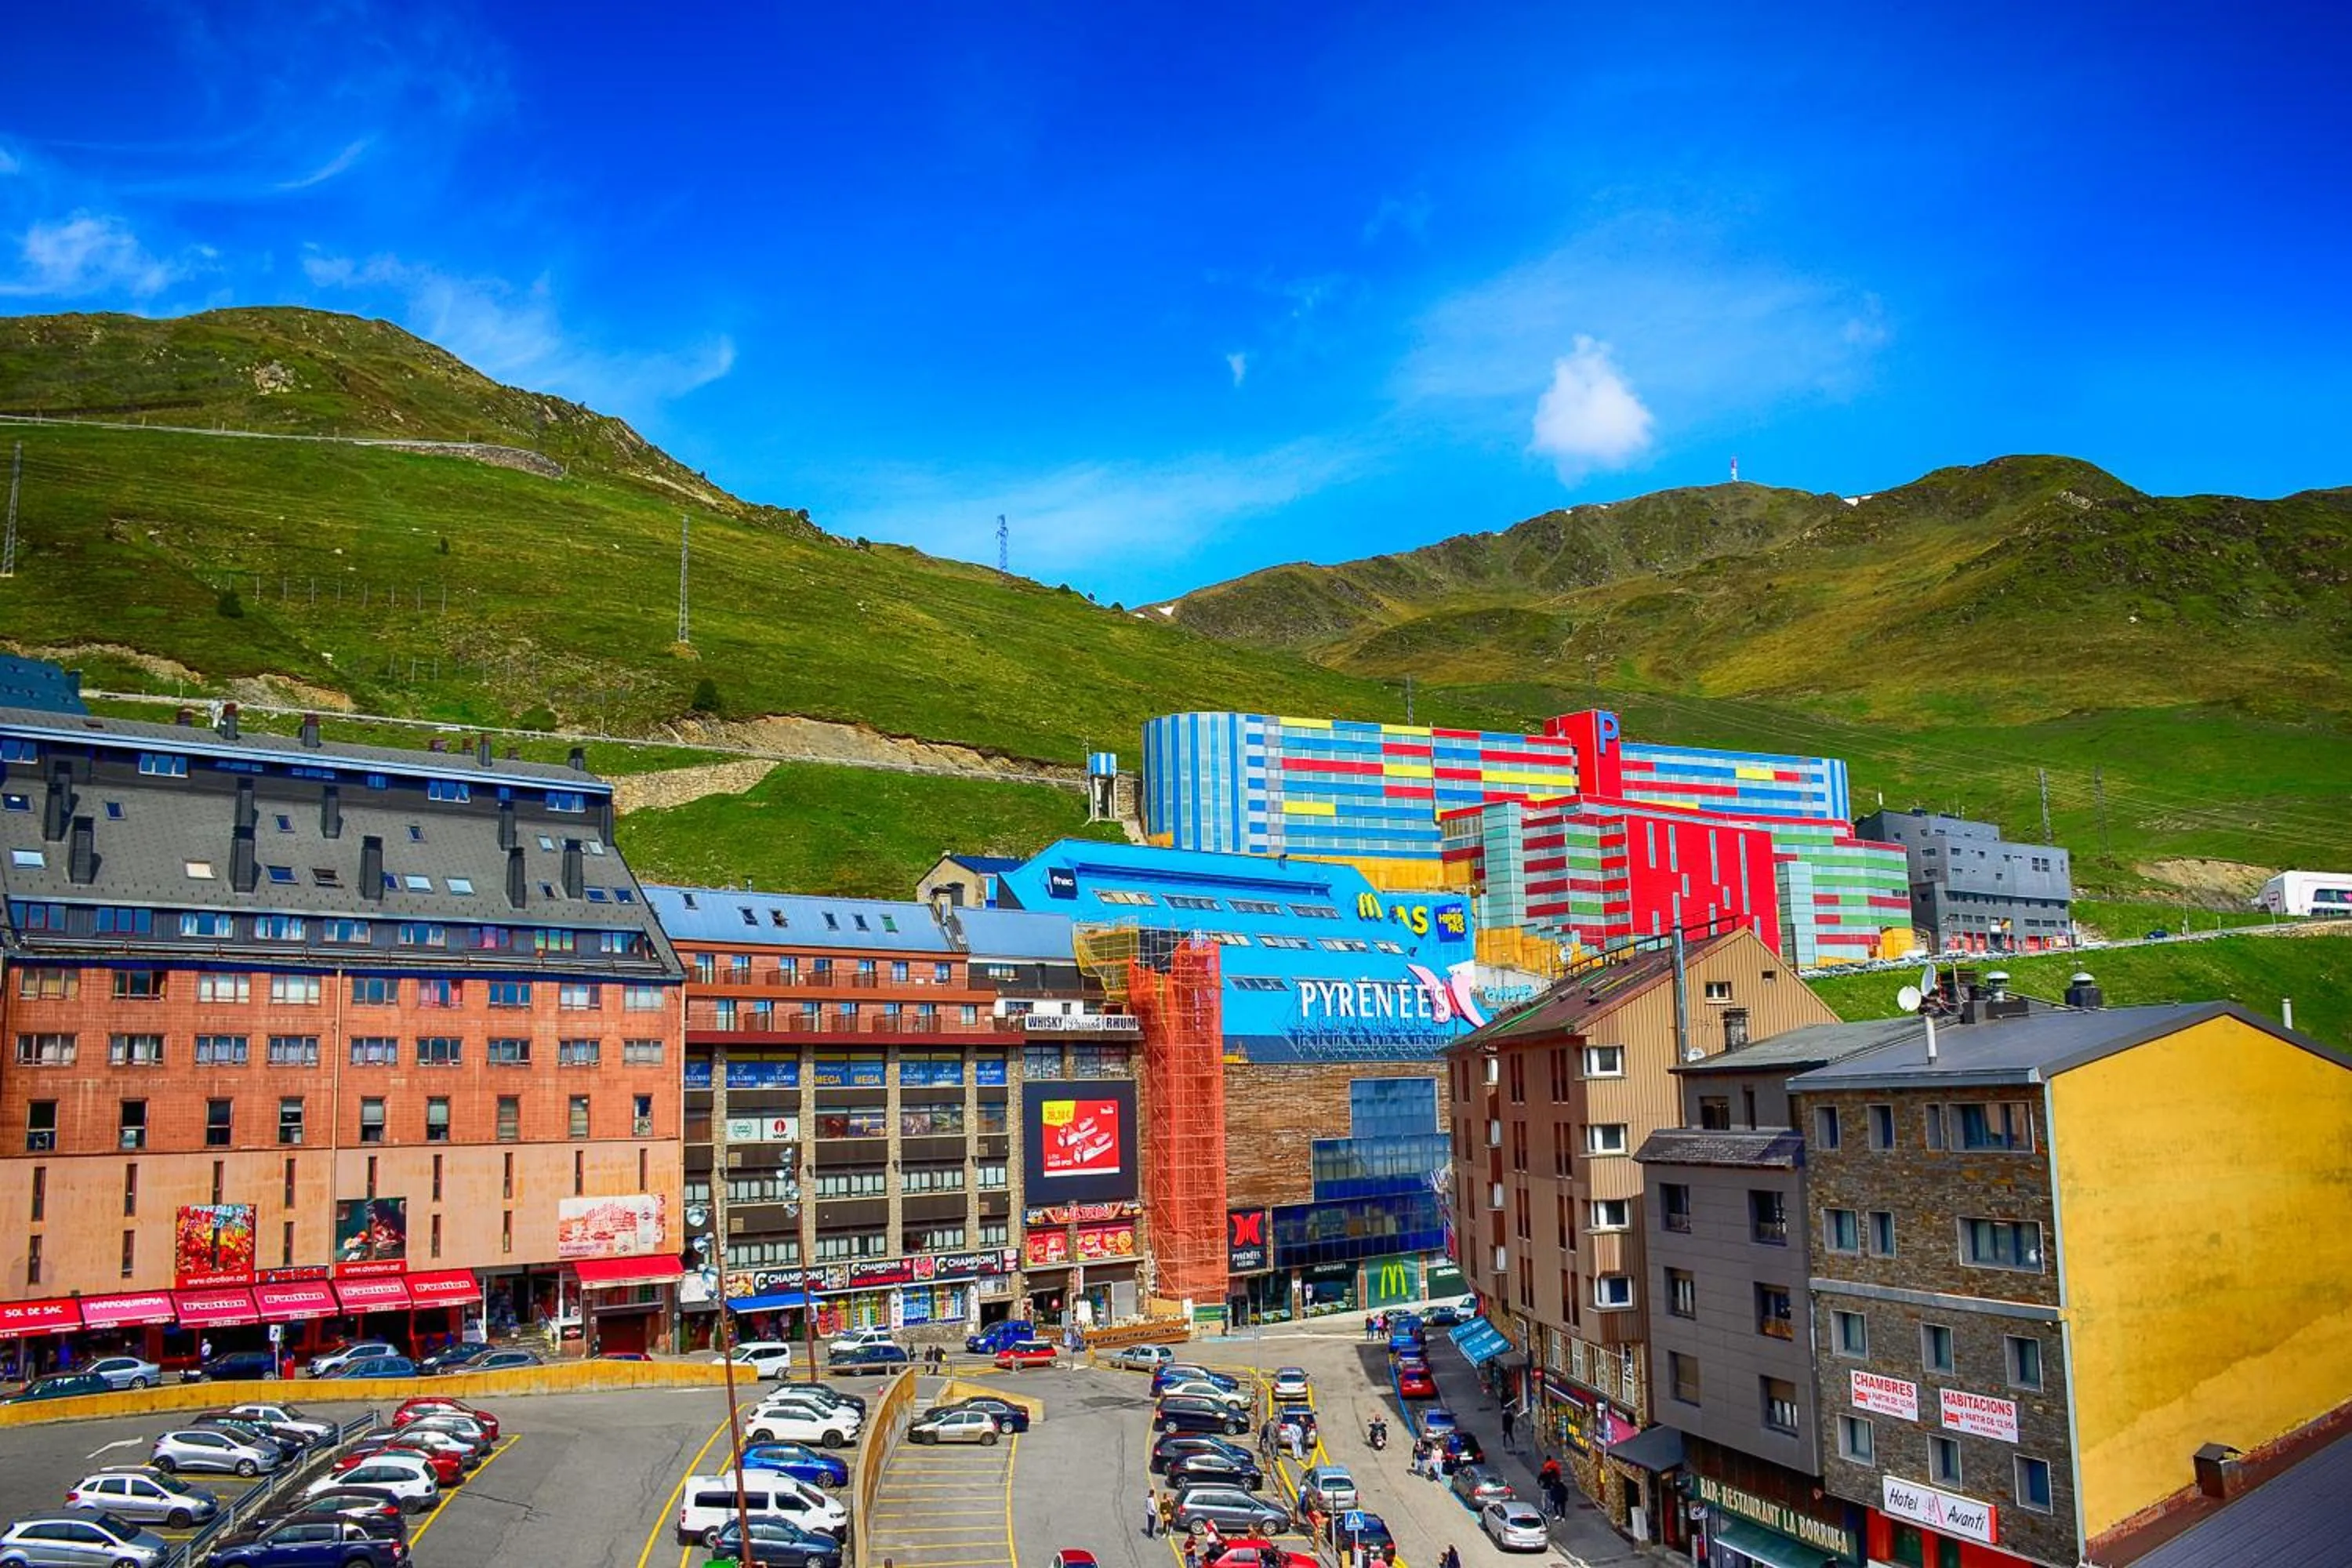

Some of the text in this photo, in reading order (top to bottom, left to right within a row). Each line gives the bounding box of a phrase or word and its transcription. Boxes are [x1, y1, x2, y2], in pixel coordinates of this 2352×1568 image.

[1597, 710, 1620, 754] P
[1053, 876, 1074, 887] fnac
[1438, 913, 1464, 924] HIPER
[1448, 922, 1465, 935] PAS
[1028, 1016, 1063, 1028] WHISKY
[1106, 1016, 1136, 1029] RHUM
[854, 1075, 881, 1085] MEGA
[768, 1270, 824, 1283] CHAMPONS
[5, 1305, 63, 1318] SOL DE SAC
[1854, 1373, 1915, 1398] CHAMBRES
[1944, 1392, 2013, 1417] HABITACIONS
[1965, 1412, 1985, 1424] PARTIR
[1986, 1417, 1994, 1426] DE
[1889, 1487, 1985, 1531] Hotel Avanti
[1783, 1509, 1797, 1535] LA
[1798, 1514, 1849, 1556] BORRUFA
